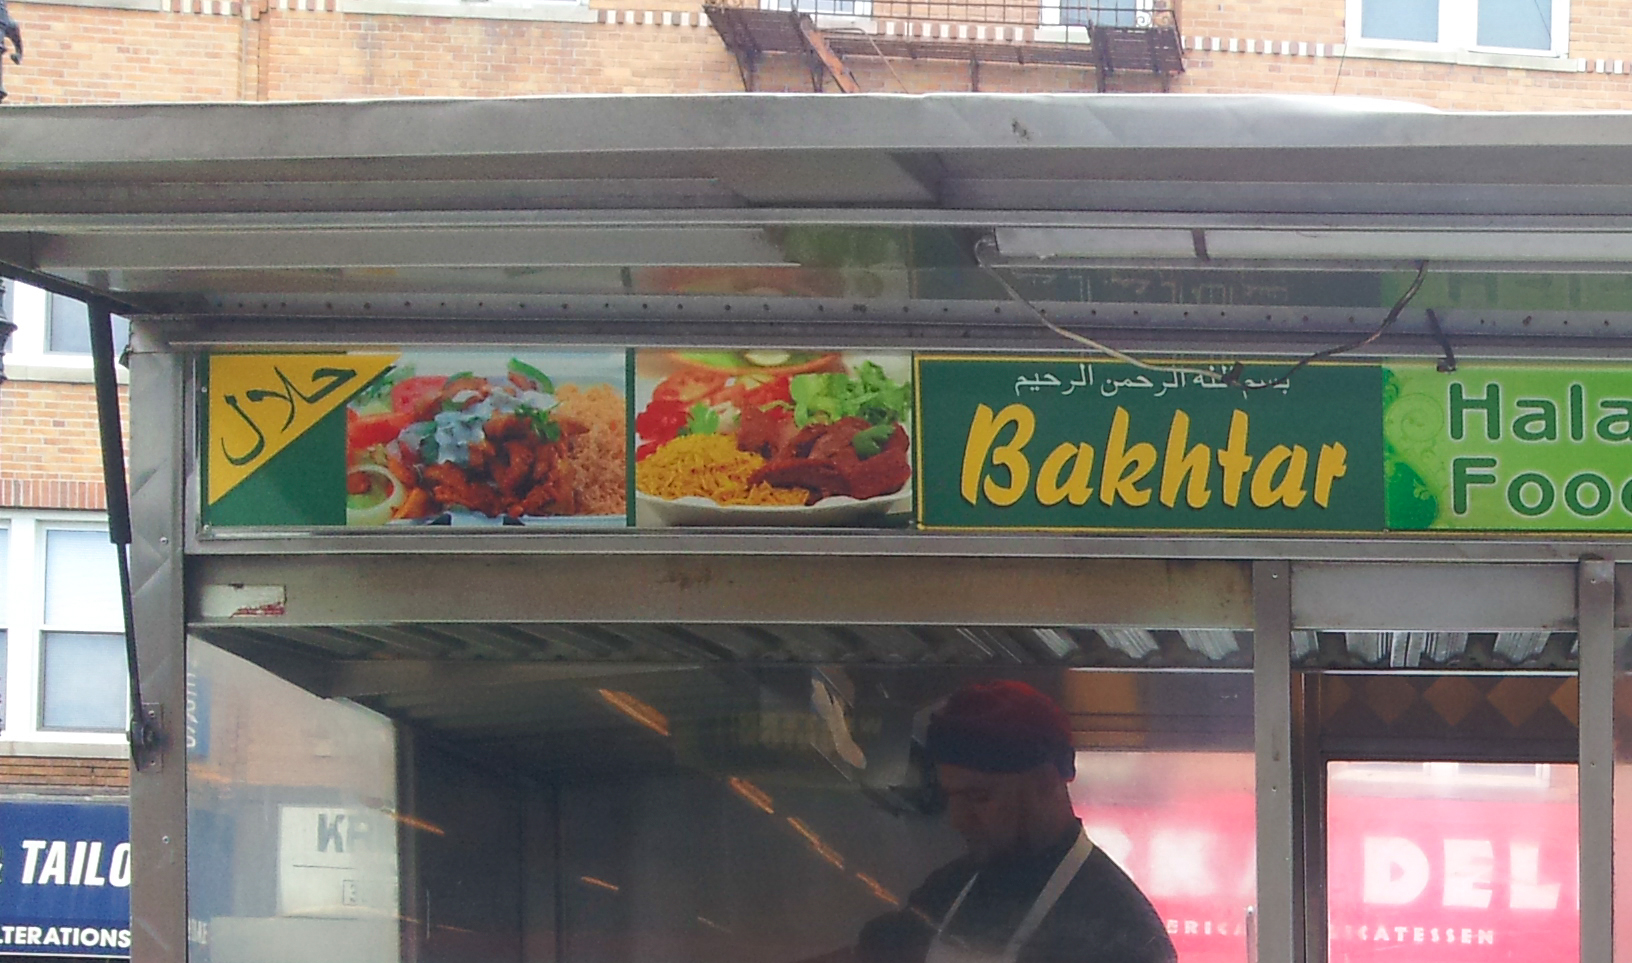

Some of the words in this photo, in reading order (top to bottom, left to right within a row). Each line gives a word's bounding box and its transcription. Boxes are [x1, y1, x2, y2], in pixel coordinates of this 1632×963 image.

[1015, 364, 1094, 396] الرحيم
[962, 405, 1346, 507] Bakhtar
[21, 840, 131, 887] TAILO
[1363, 836, 1580, 910] DEL
[0, 925, 131, 948] TERATIONS
